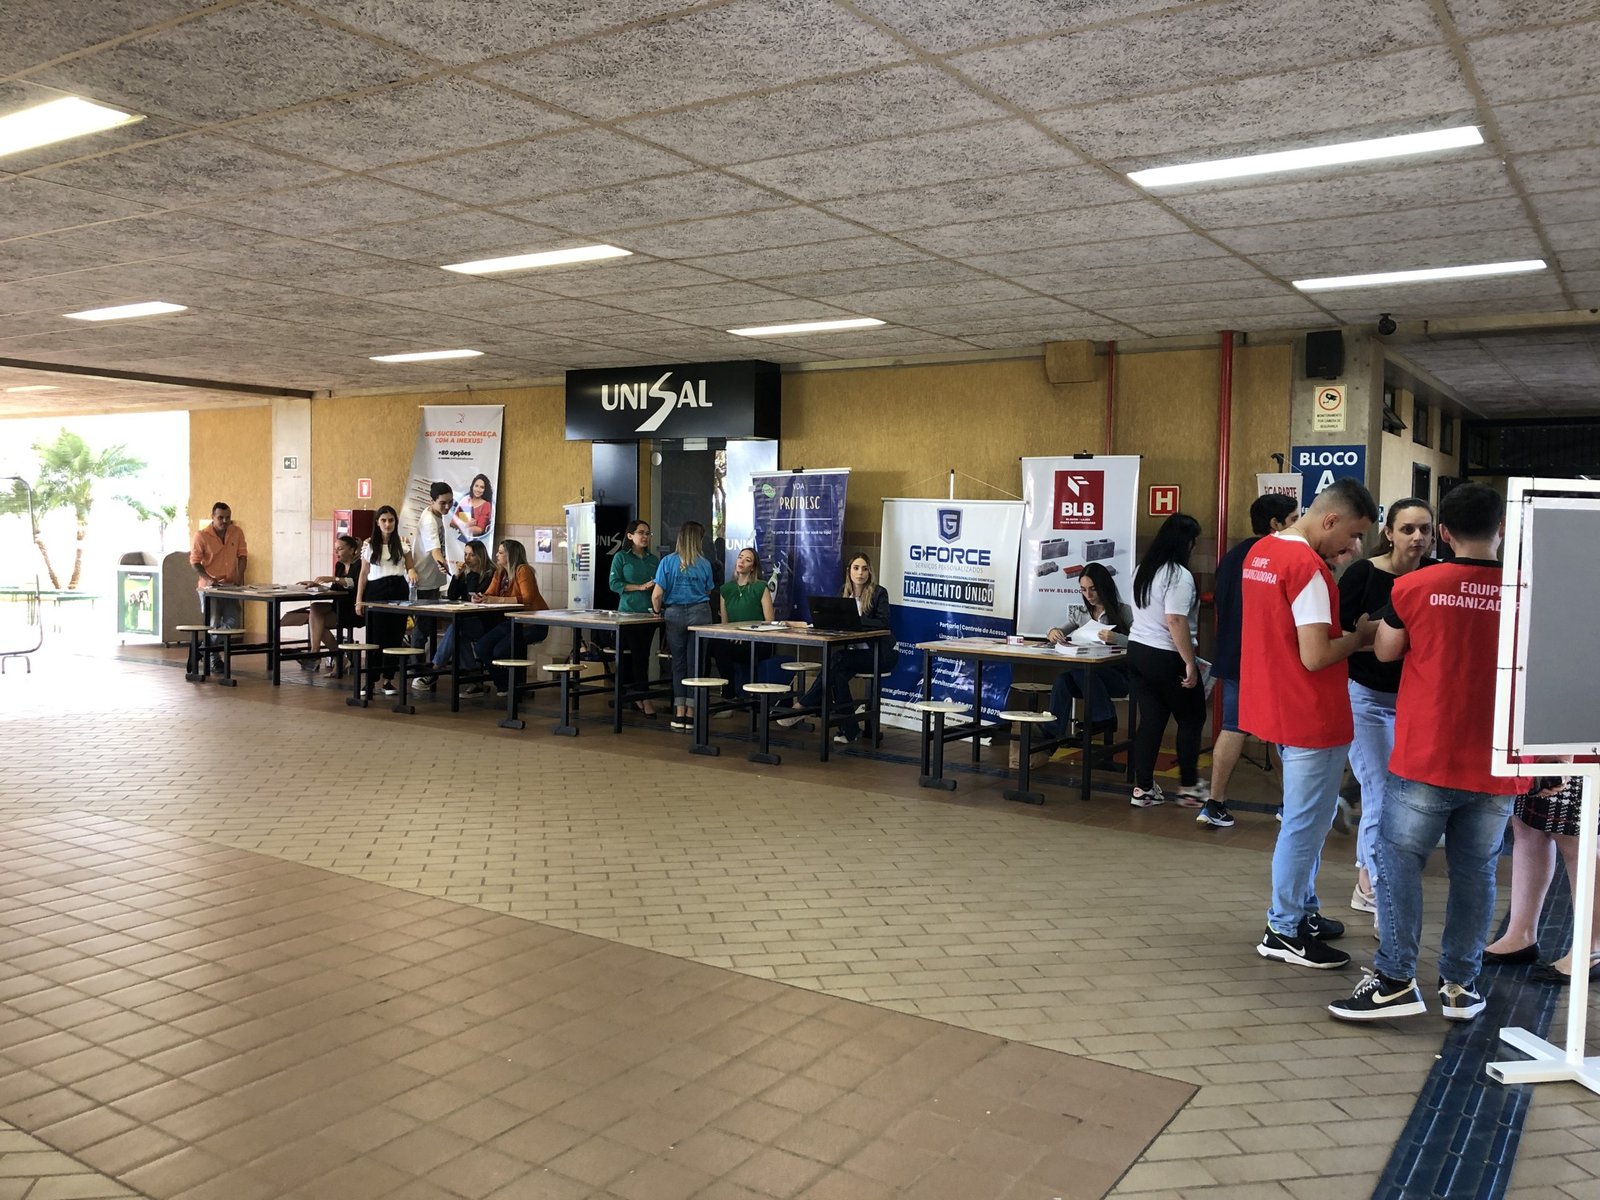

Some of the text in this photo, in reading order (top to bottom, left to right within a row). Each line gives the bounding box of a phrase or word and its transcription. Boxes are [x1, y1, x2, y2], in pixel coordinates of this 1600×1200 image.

[601, 372, 713, 432] UNISAL
[1300, 452, 1358, 466] BLOCO
[1315, 470, 1335, 494] A
[1061, 502, 1095, 516] BLB
[1156, 491, 1173, 511] H
[915, 562, 983, 574] SERVIÇOS PERSONALIZADOS
[1252, 557, 1270, 568] EQUIPE
[905, 580, 994, 603] TRATAMENTO ÚNICO
[1430, 594, 1502, 612] ORGANIZAD
[939, 621, 960, 630] Portaria
[962, 625, 981, 633] Controle
